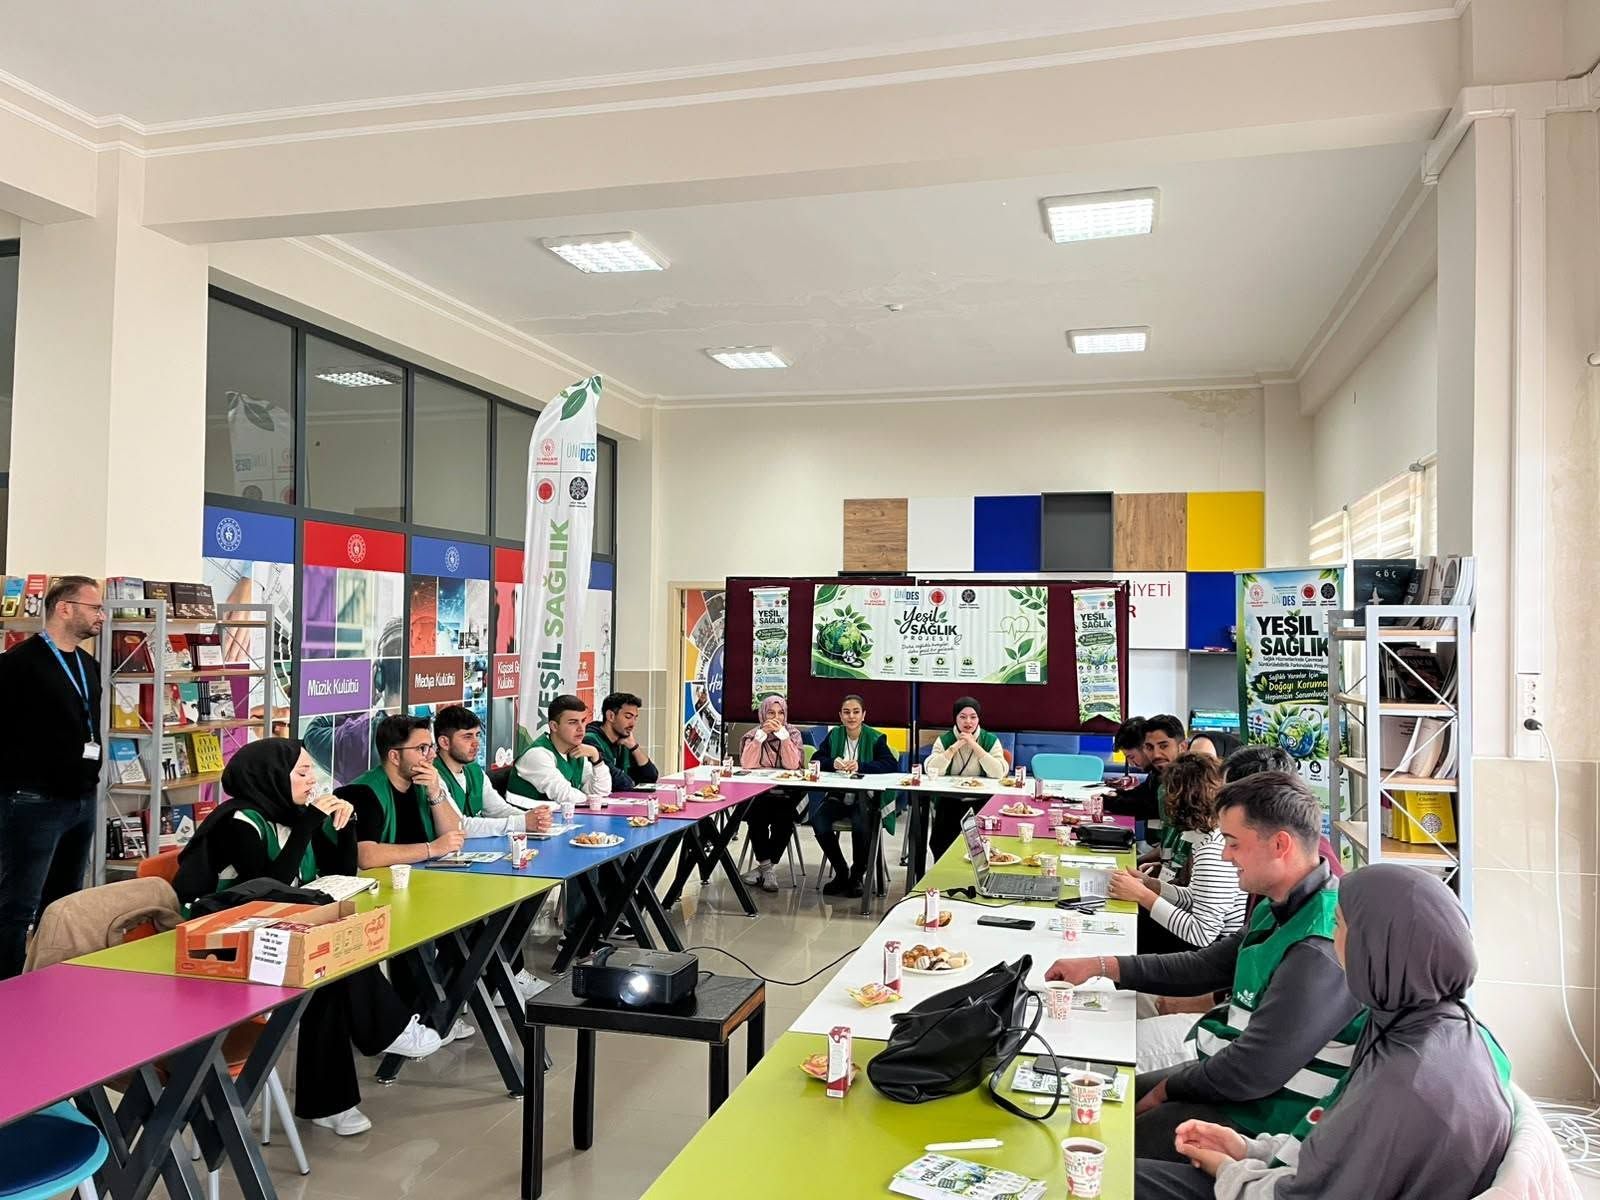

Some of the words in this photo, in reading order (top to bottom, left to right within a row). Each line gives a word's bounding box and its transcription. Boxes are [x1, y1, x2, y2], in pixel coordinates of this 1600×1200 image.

[543, 519, 569, 638] SAĞLIK
[1129, 580, 1171, 597] İYETİ
[899, 606, 939, 635] Yeşil
[910, 622, 958, 636] SAĞLIK
[307, 678, 332, 696] Müzik
[333, 677, 359, 695] Kulübü
[414, 673, 435, 689] Medya
[435, 672, 456, 687] Kulübü
[1268, 681, 1294, 693] Doğayı
